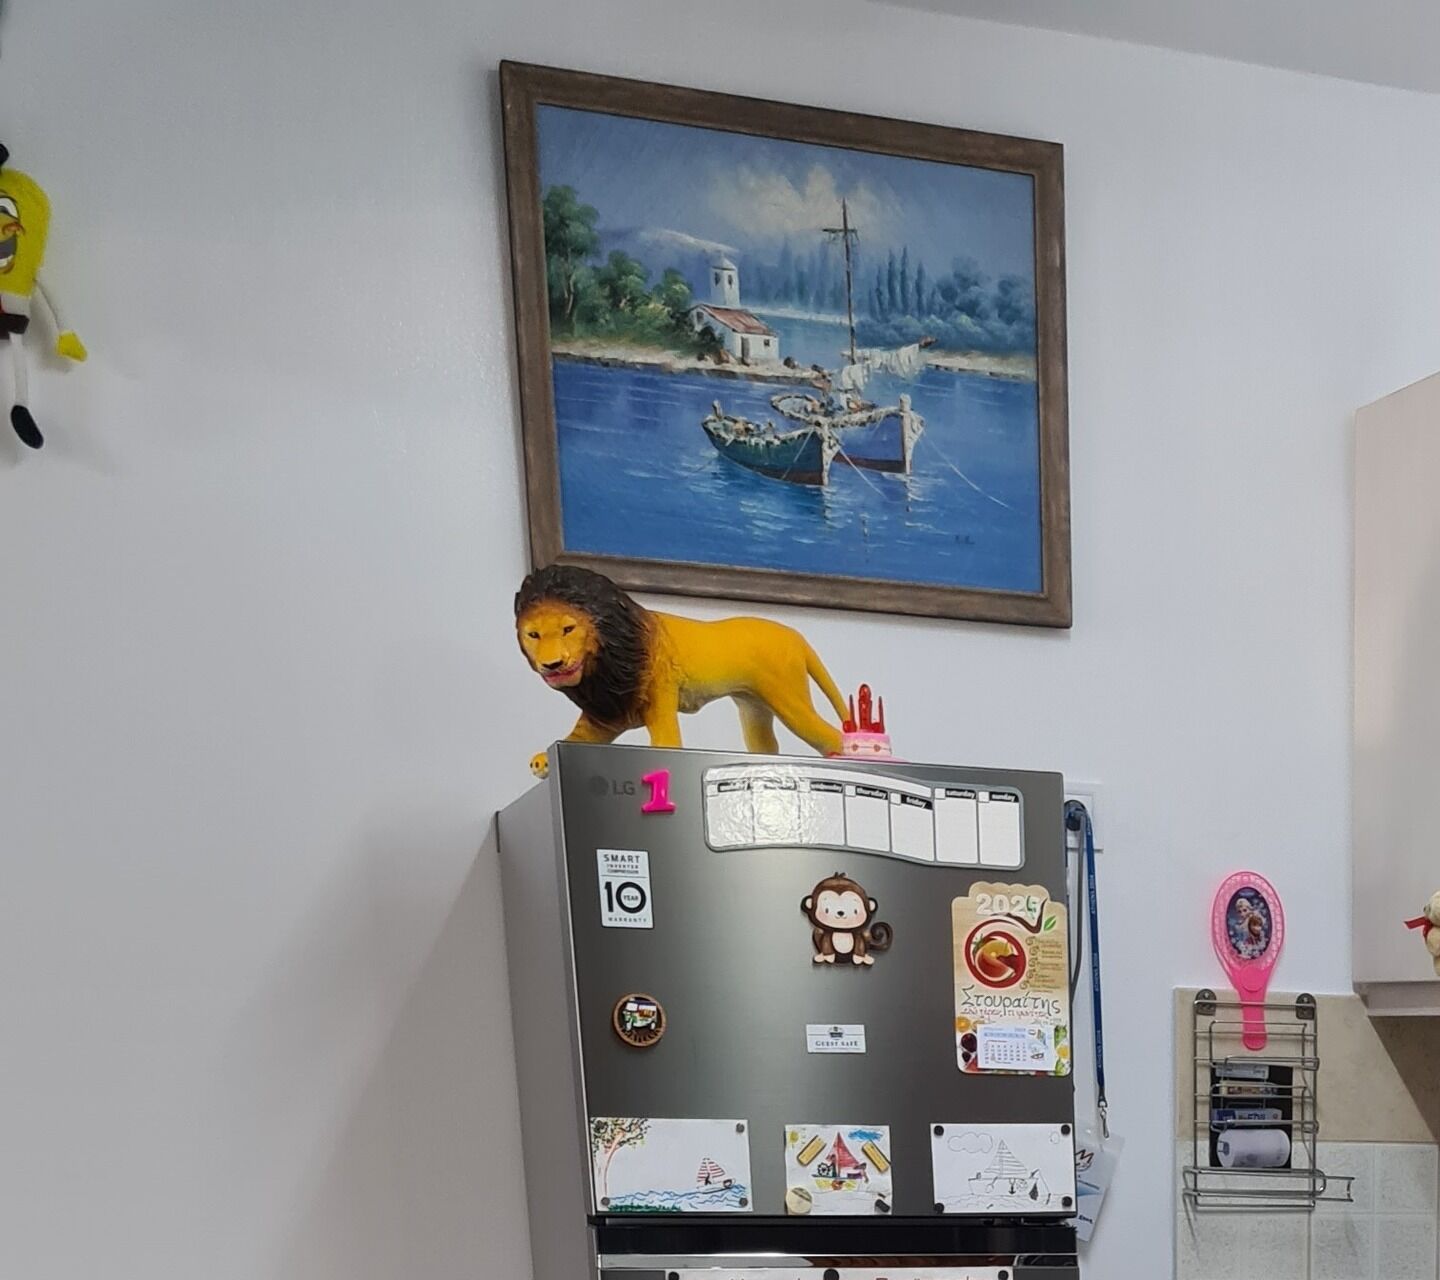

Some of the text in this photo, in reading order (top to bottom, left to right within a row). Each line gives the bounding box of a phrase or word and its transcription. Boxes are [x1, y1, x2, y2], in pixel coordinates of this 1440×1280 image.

[612, 782, 636, 796] LG
[641, 769, 677, 814] 1
[603, 854, 641, 864] SMART
[605, 881, 647, 914] 10
